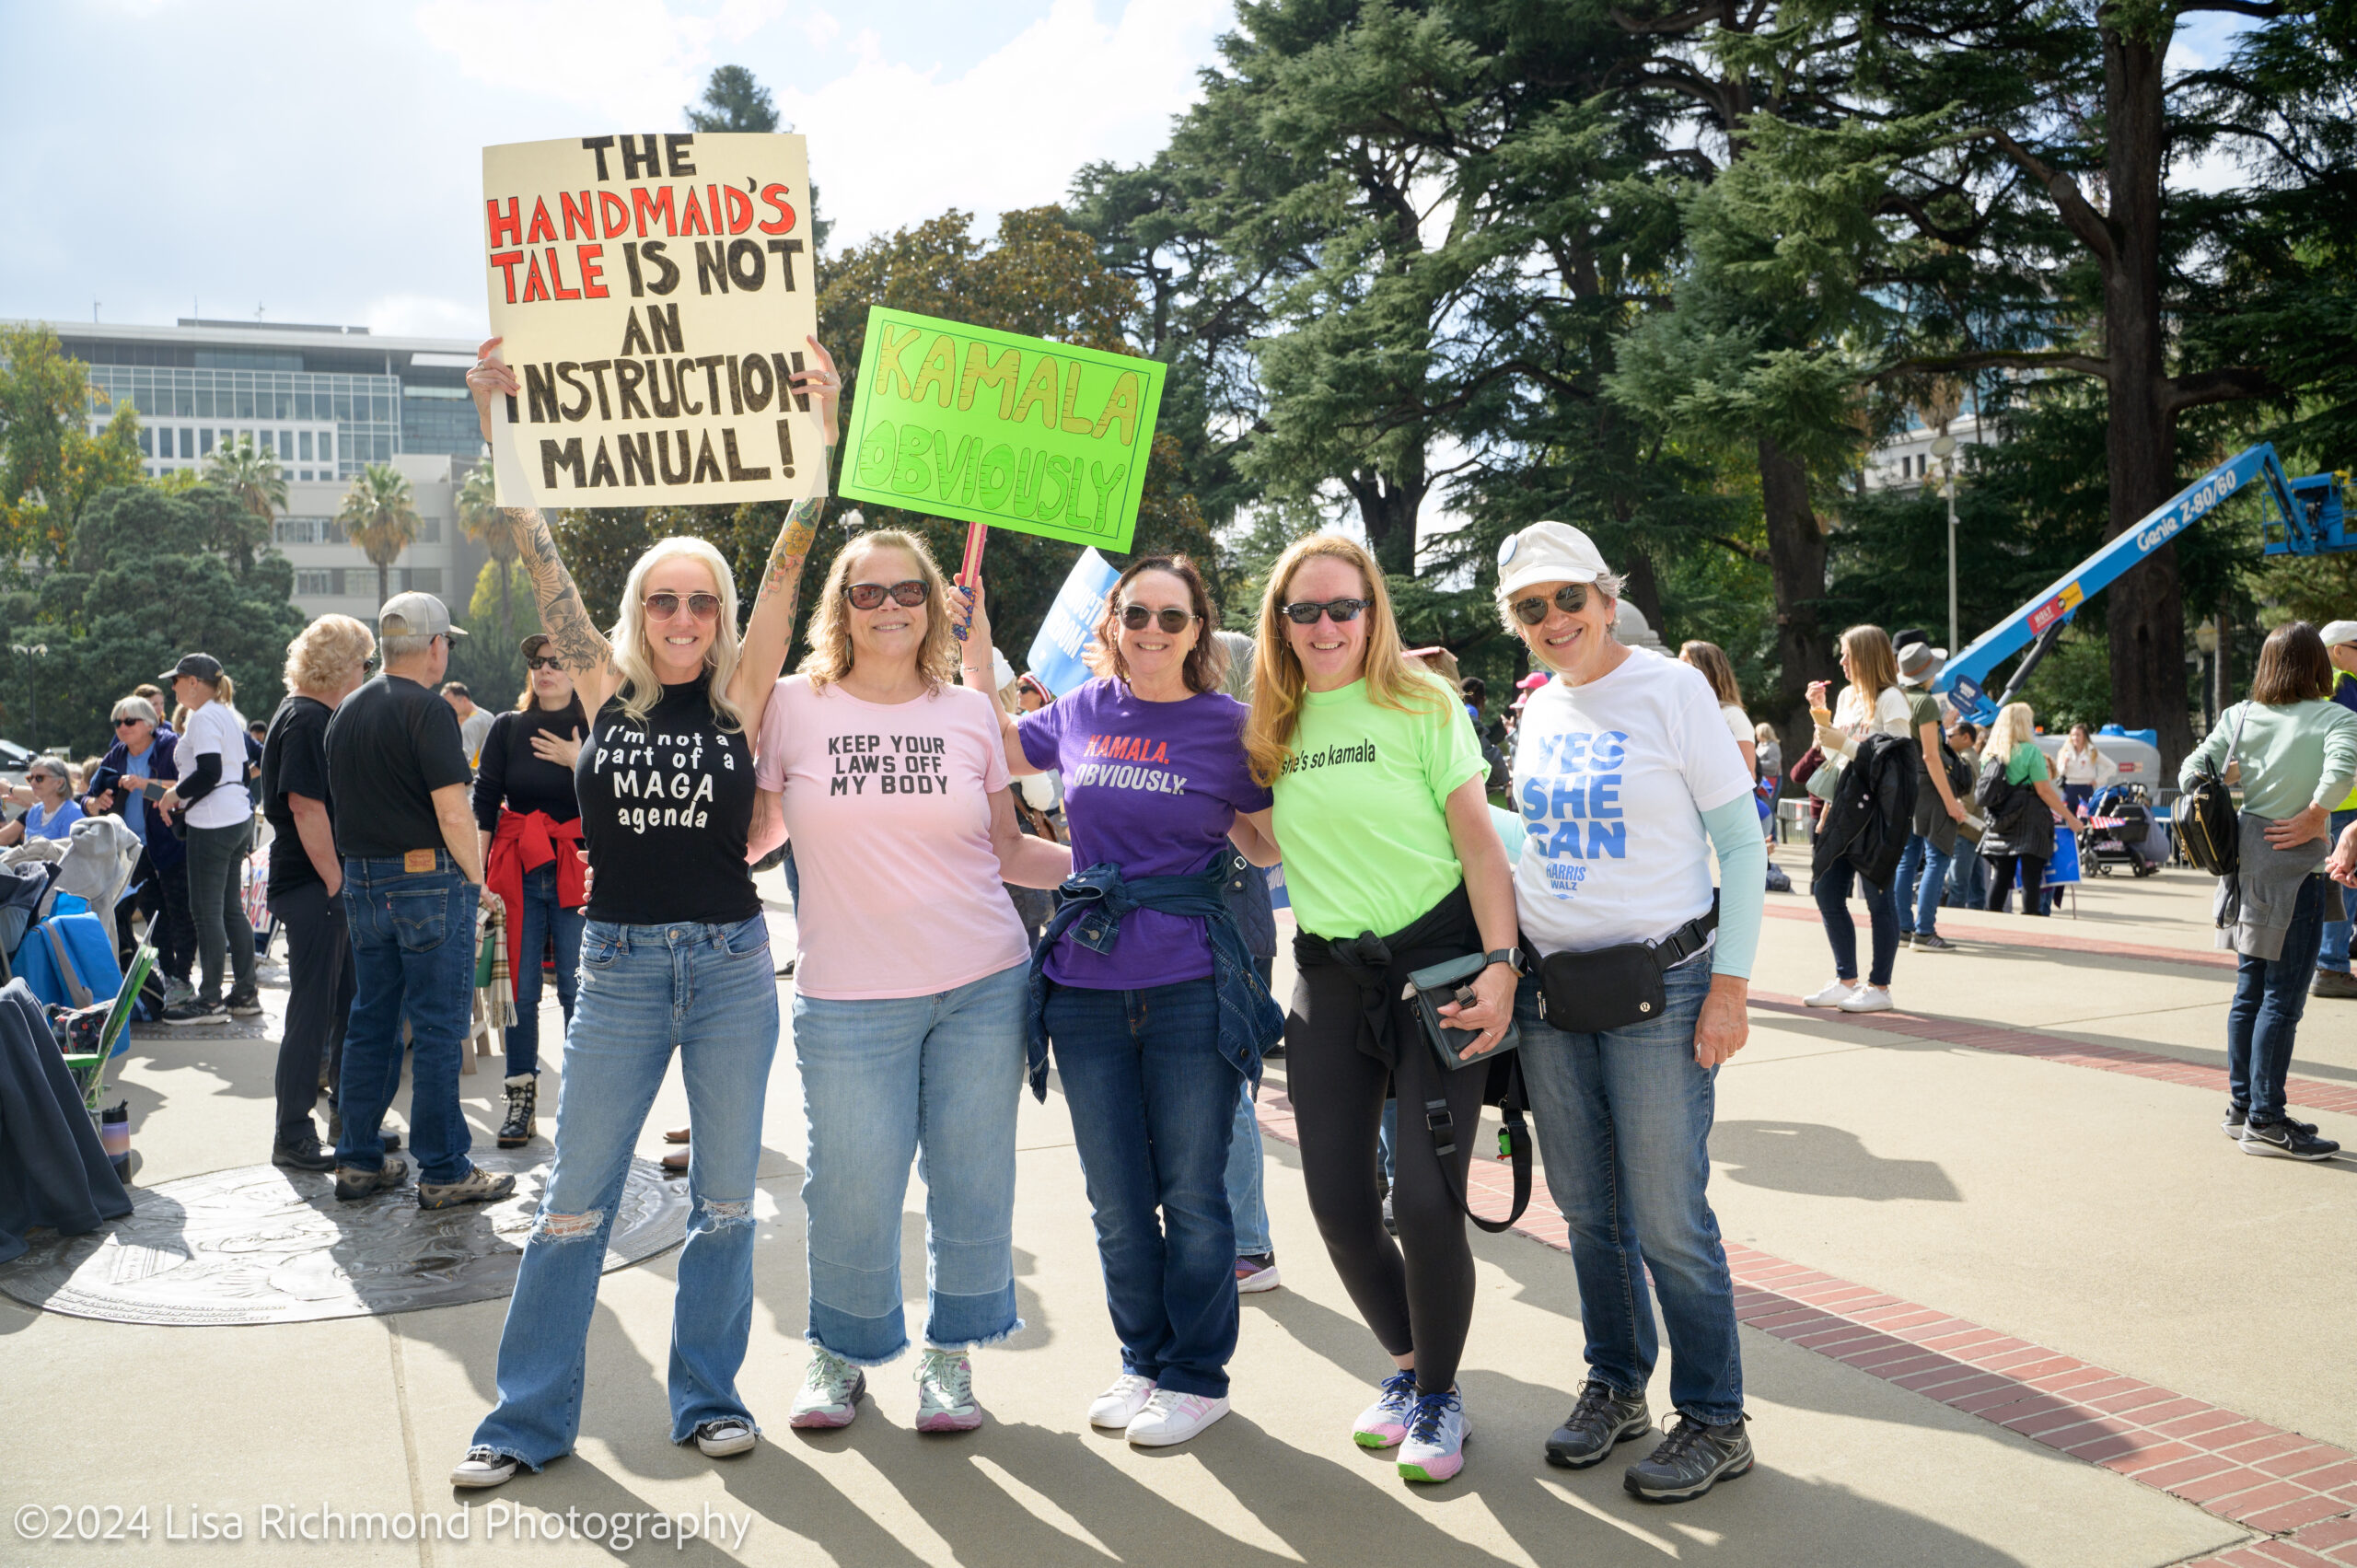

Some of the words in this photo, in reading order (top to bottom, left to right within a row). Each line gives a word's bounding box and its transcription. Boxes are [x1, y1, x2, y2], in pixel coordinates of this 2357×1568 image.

[582, 134, 697, 181] THE
[486, 176, 796, 249] HANDMAID'S
[490, 243, 610, 304] TALE
[622, 240, 680, 297] IS
[694, 238, 805, 296] NOT
[621, 302, 685, 357] AN
[505, 351, 811, 424] INSTRUCTION
[876, 324, 1139, 447] KAMALA
[859, 420, 1125, 533] OBVIOUSLY
[2137, 517, 2179, 552] Genie
[2179, 469, 2236, 524] Z-80/60
[604, 725, 644, 744] I'm
[657, 732, 702, 747] not
[715, 735, 729, 747] a
[828, 735, 880, 755] KEEP
[889, 735, 946, 754] YOUR
[1083, 734, 1170, 765] KAMALA.
[1538, 730, 1629, 774] YES
[594, 746, 655, 774] part
[672, 747, 703, 770] of
[723, 752, 735, 771] a
[835, 755, 896, 774] LAWS
[905, 756, 942, 773] OFF
[1310, 751, 1326, 769] so
[1328, 738, 1376, 766] kamala
[613, 769, 714, 802] MAGA
[830, 775, 866, 796] MY
[881, 775, 947, 795] BODY
[1073, 763, 1188, 796] OBVIOUSLY.
[1522, 773, 1624, 820] SHE
[618, 800, 708, 834] agenda
[1546, 863, 1586, 882] HARRIS
[1550, 879, 1578, 891] WALZ
